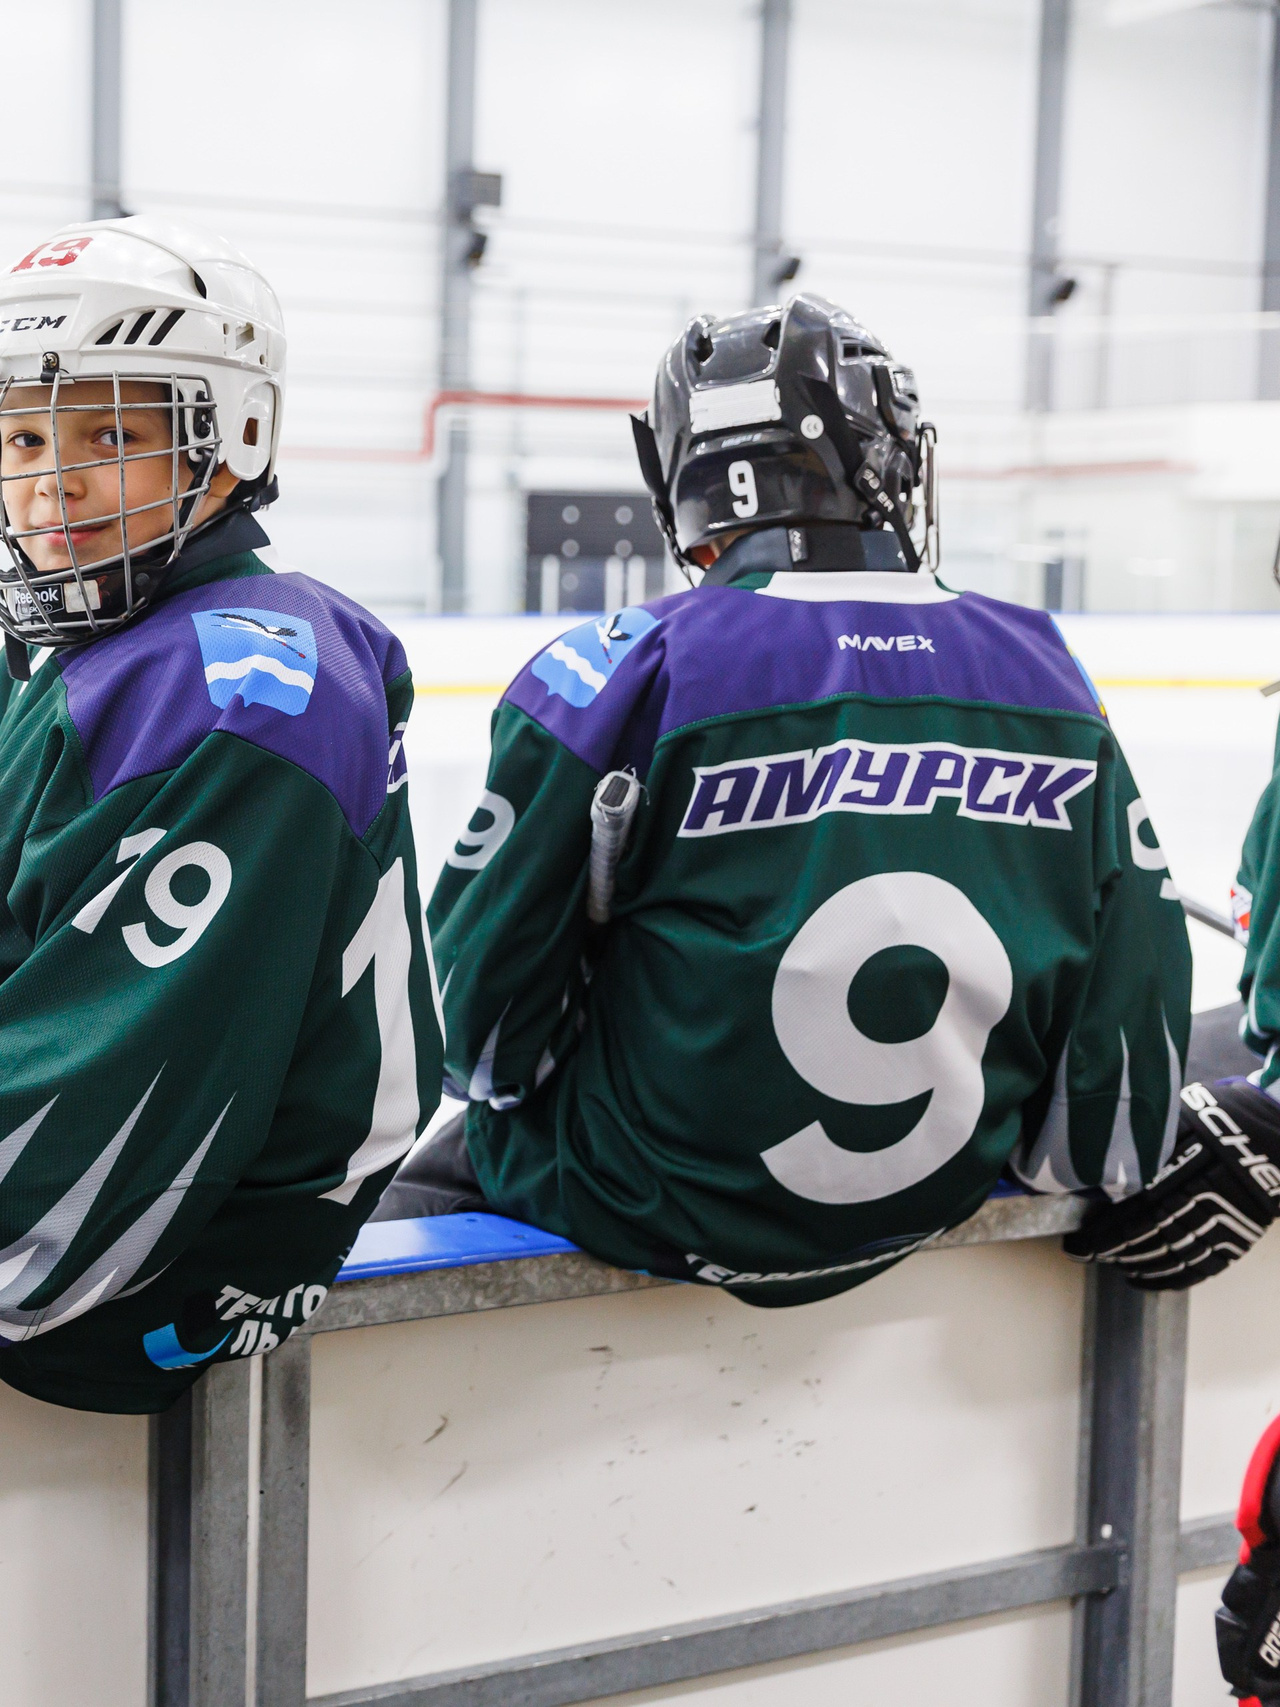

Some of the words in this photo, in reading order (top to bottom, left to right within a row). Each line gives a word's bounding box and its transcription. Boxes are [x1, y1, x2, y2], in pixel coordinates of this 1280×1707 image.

[10, 237, 94, 274] 19
[727, 459, 759, 518] 9
[837, 633, 936, 653] MAVEX
[446, 788, 516, 871] 9
[677, 739, 1098, 839] АМУРСК
[71, 827, 233, 968] 19
[319, 857, 447, 1206] 1
[760, 871, 1013, 1205] 9
[1180, 1082, 1280, 1198] SCHE
